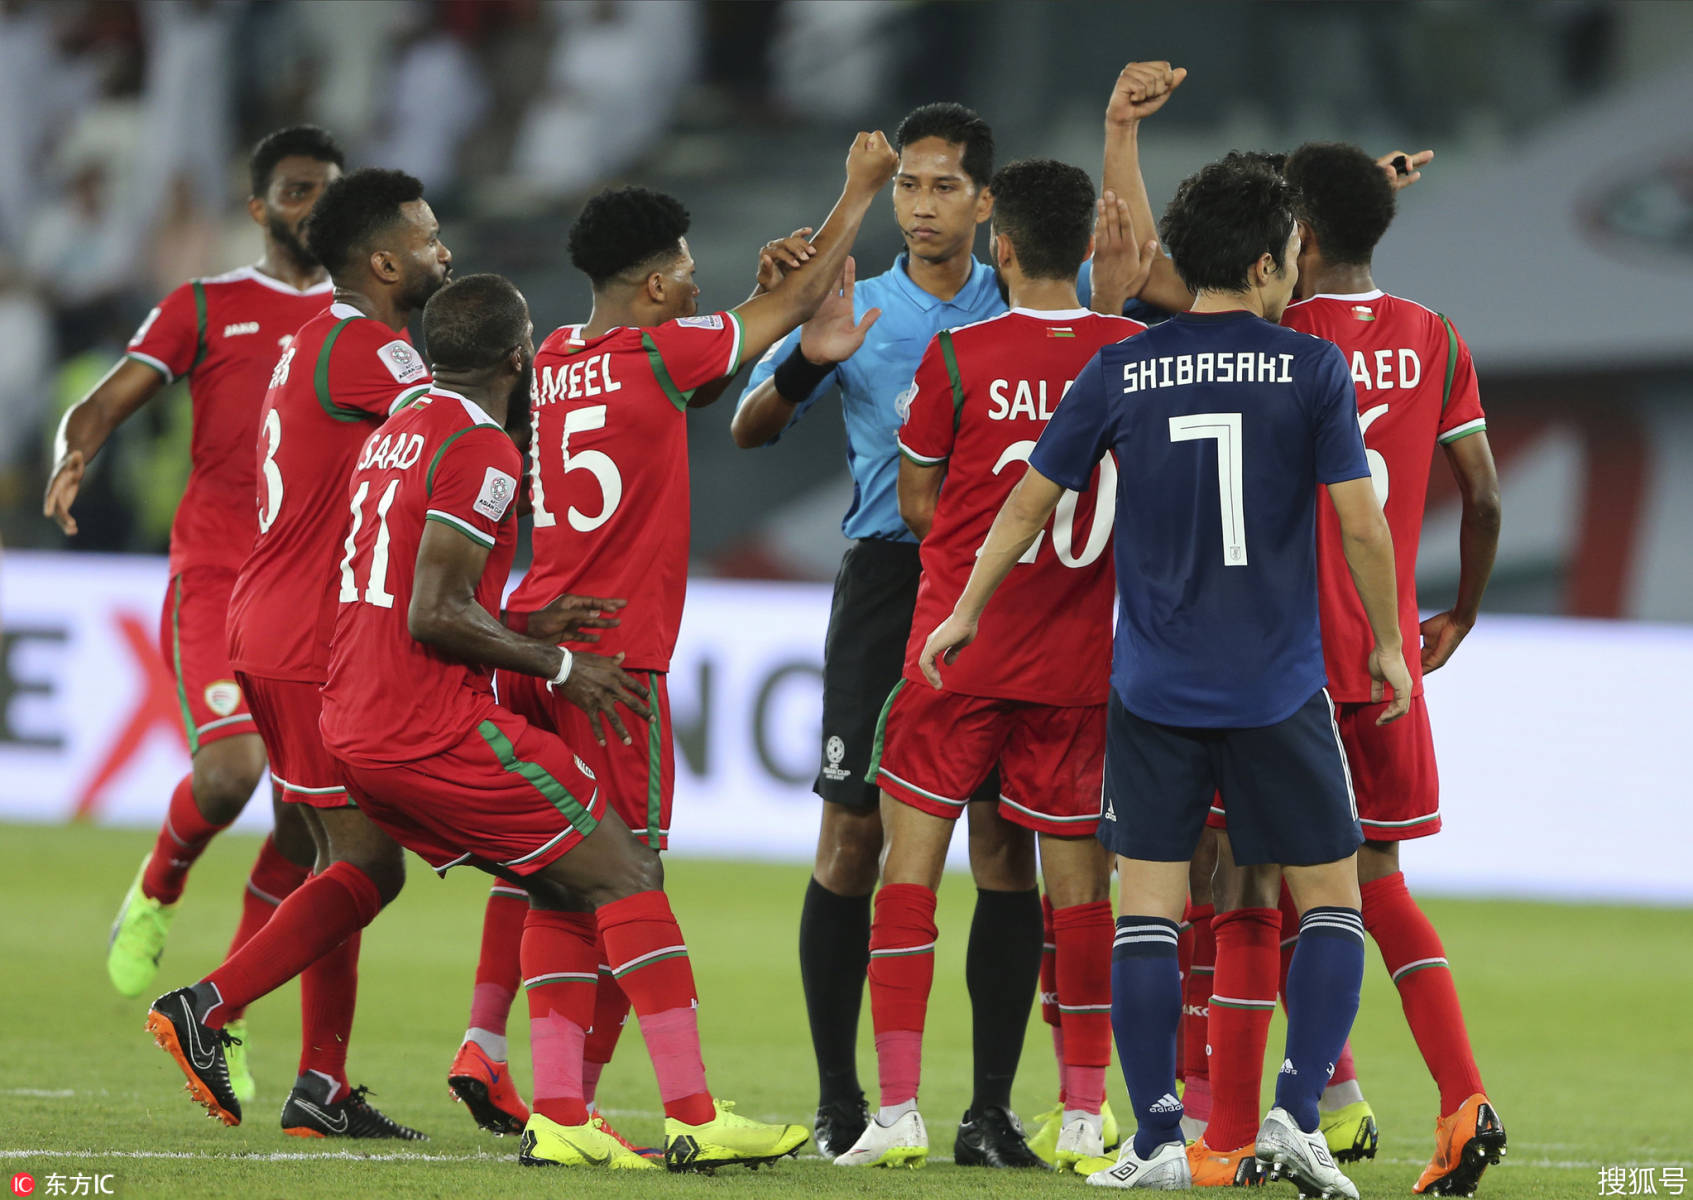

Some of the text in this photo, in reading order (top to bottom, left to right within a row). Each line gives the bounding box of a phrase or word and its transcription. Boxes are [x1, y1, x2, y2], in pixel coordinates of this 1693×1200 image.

[1123, 352, 1294, 394] SHIBASAKI
[257, 408, 284, 534] 3
[358, 433, 425, 471] SAAD
[530, 405, 623, 532] 15
[1169, 412, 1248, 566] 7
[339, 479, 400, 608] 11
[1150, 1103, 1184, 1113] adida
